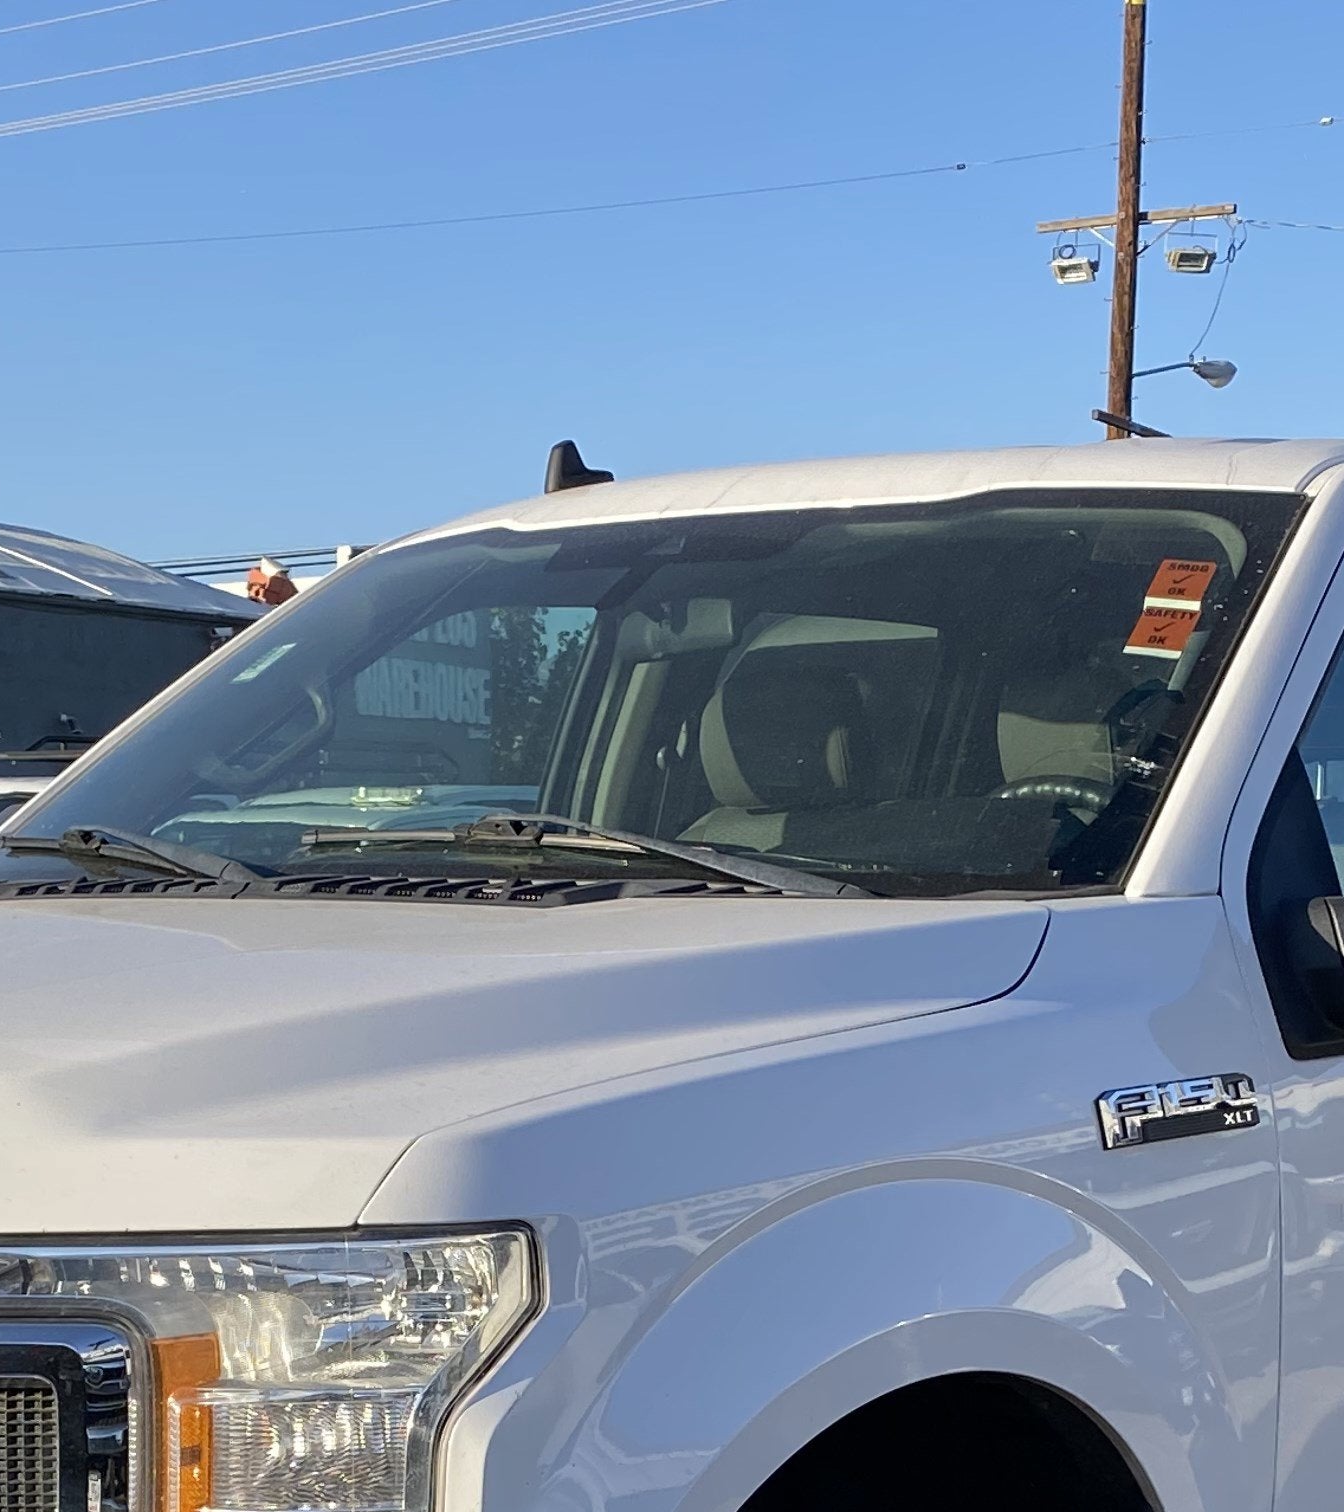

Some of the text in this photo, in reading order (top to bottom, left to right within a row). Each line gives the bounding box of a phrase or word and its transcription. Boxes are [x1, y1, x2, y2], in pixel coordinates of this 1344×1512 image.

[1168, 587, 1187, 596] OK
[1145, 607, 1198, 620] SAFETY
[1223, 1109, 1254, 1125] XLT
